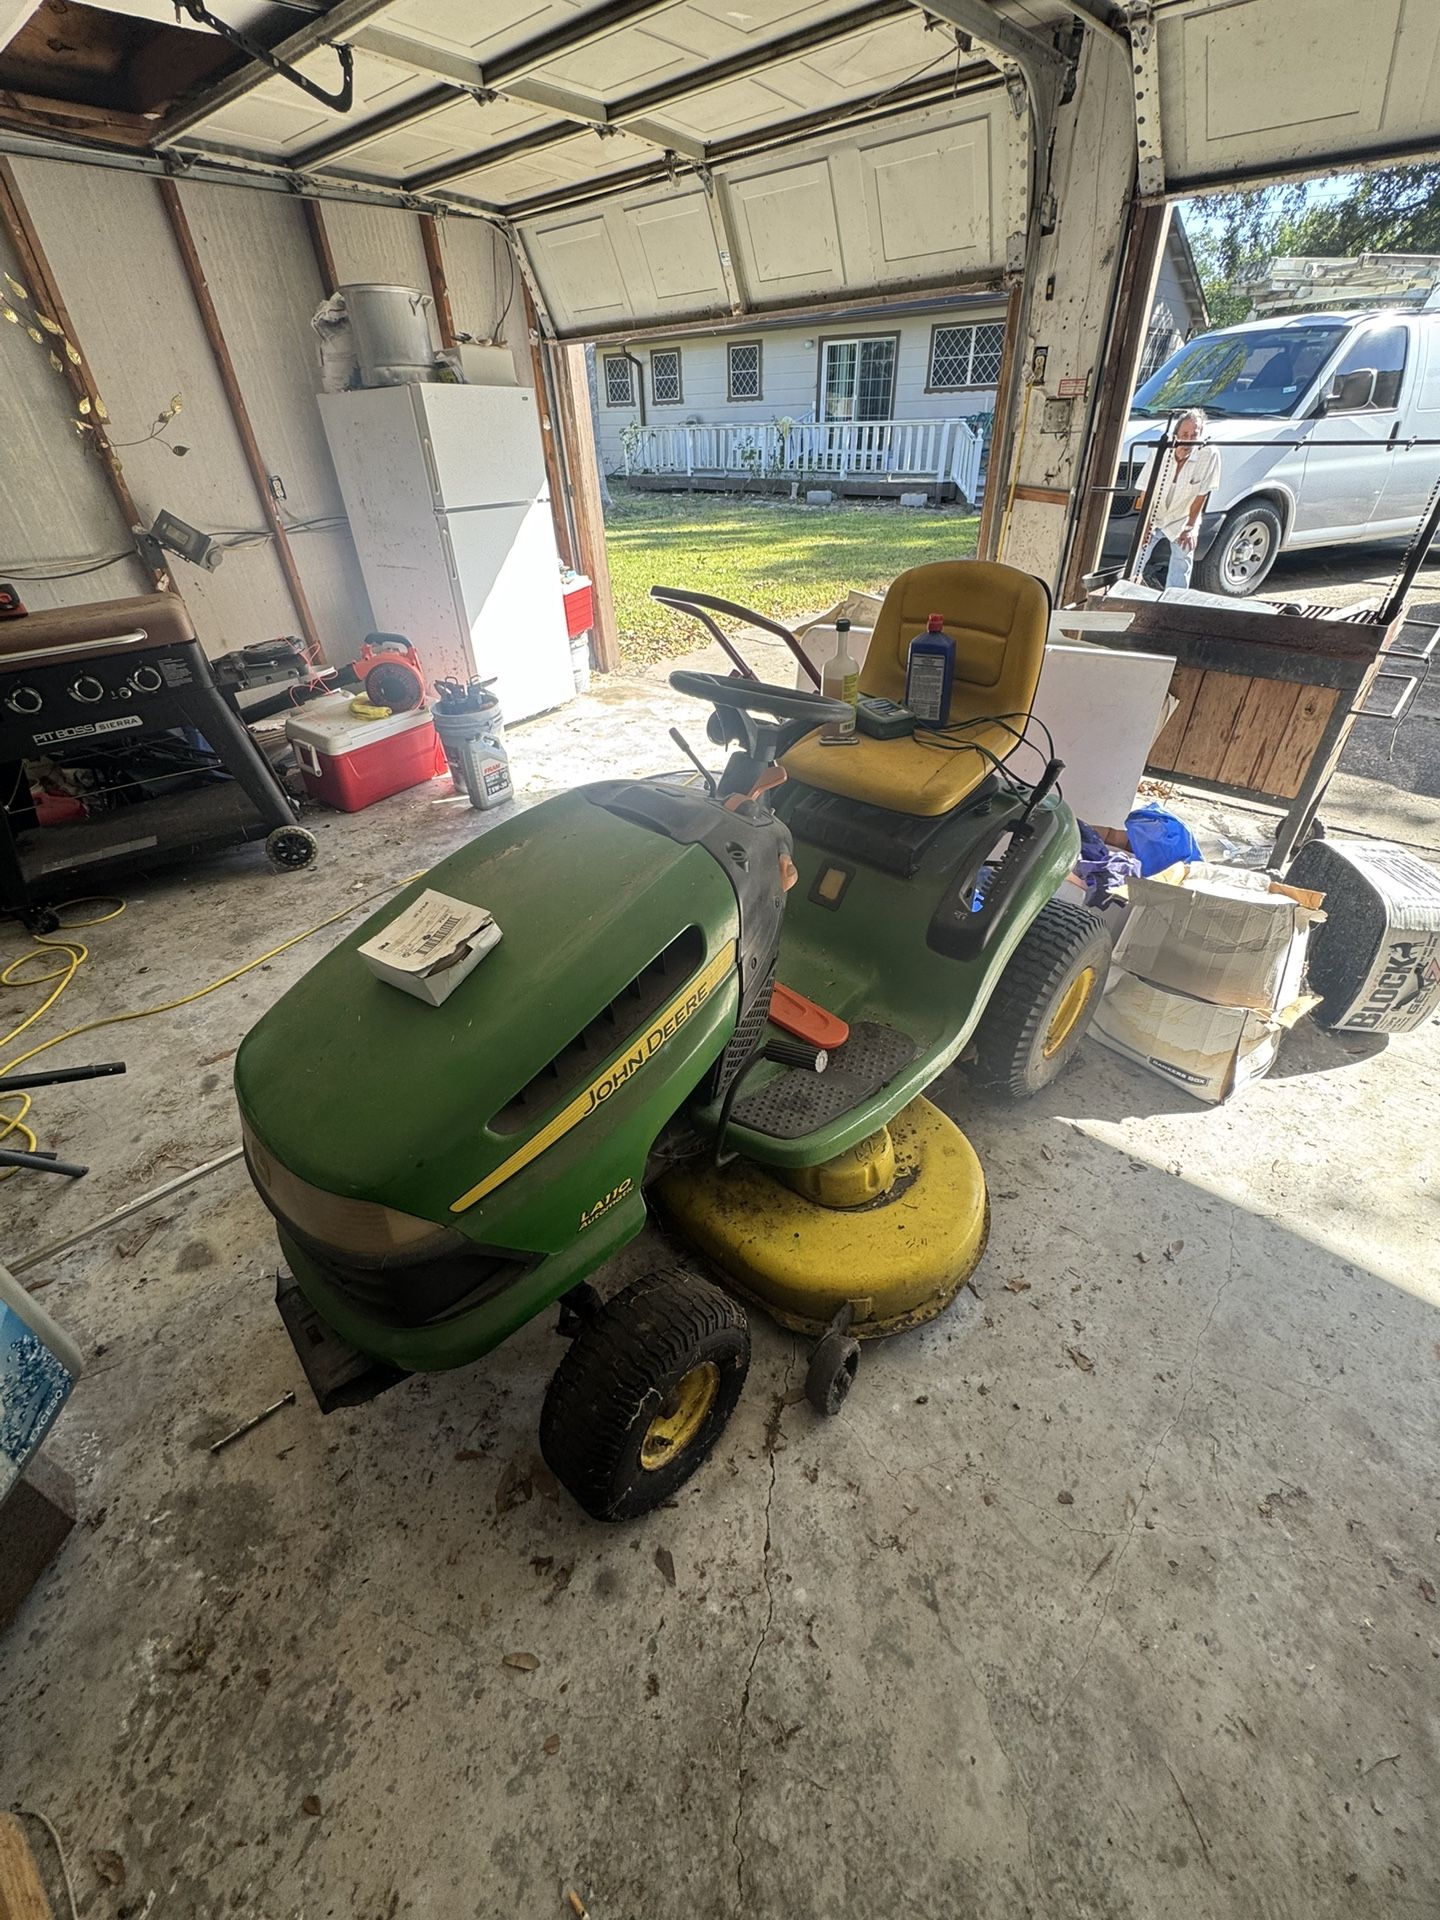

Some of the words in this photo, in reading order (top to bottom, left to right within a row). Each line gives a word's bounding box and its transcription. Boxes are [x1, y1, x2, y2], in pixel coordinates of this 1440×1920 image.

[32, 730, 56, 744] PIT
[55, 723, 96, 740] BOSS
[98, 717, 139, 731] SIERRA
[484, 762, 501, 774] FRAM
[1343, 955, 1418, 1029] BLOCK
[584, 1048, 644, 1116] JOHN
[646, 981, 710, 1055] DEERE
[1152, 1060, 1187, 1079] BANKERS
[1187, 1075, 1206, 1084] BOX
[578, 1183, 636, 1232] Automatic
[580, 1176, 632, 1223] LA110
[29, 1388, 64, 1442] EXCESO
